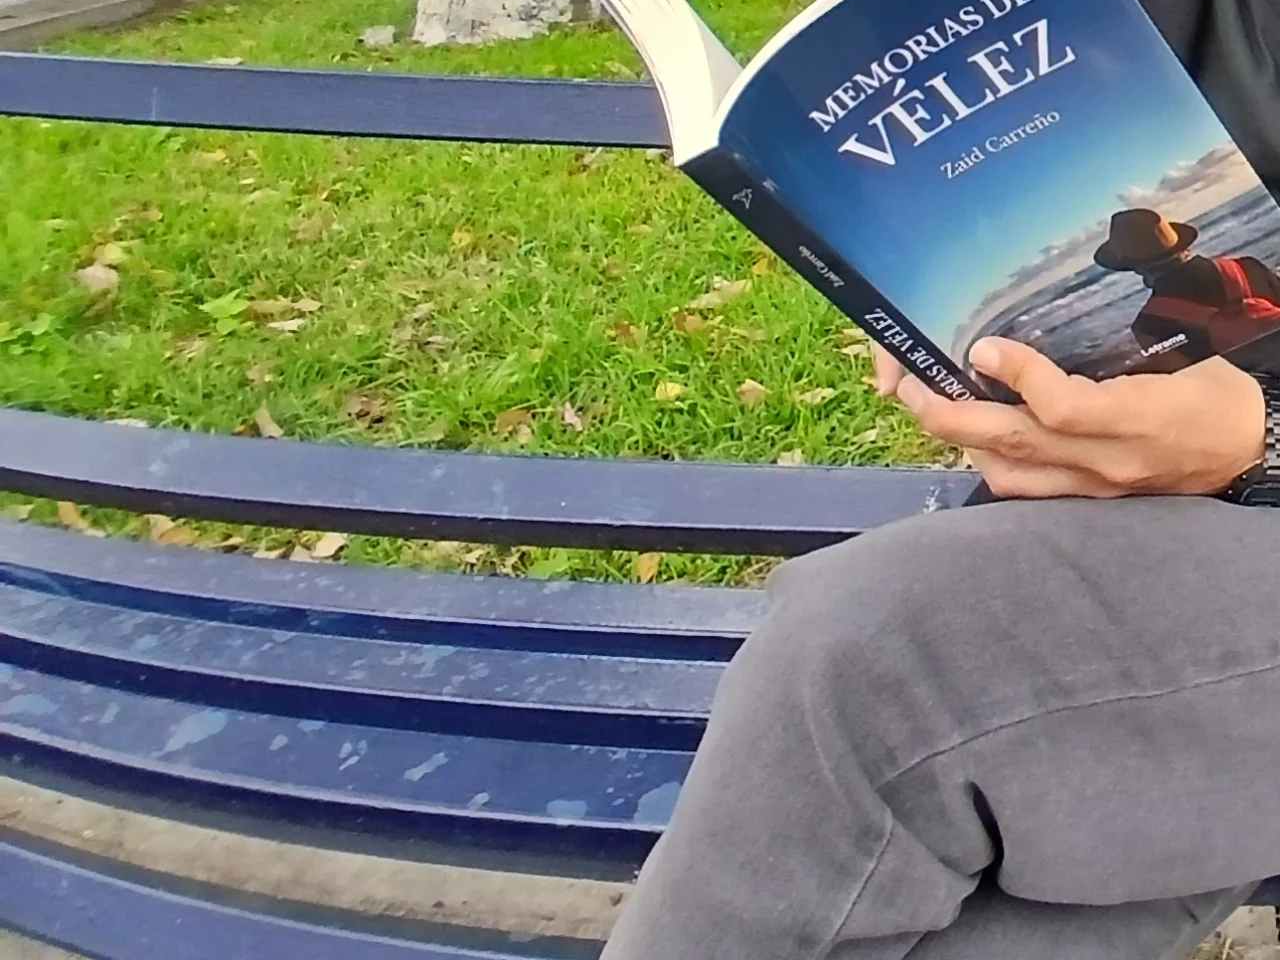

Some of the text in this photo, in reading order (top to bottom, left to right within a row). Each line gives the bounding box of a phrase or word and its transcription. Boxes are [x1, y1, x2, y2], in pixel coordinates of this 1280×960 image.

[808, 6, 984, 133] MEMORIAS
[838, 18, 1076, 166] VÉLEZ
[940, 109, 1061, 180] Zaid Carreño
[863, 308, 914, 352] VÉLEZ
[906, 346, 936, 369] DE
